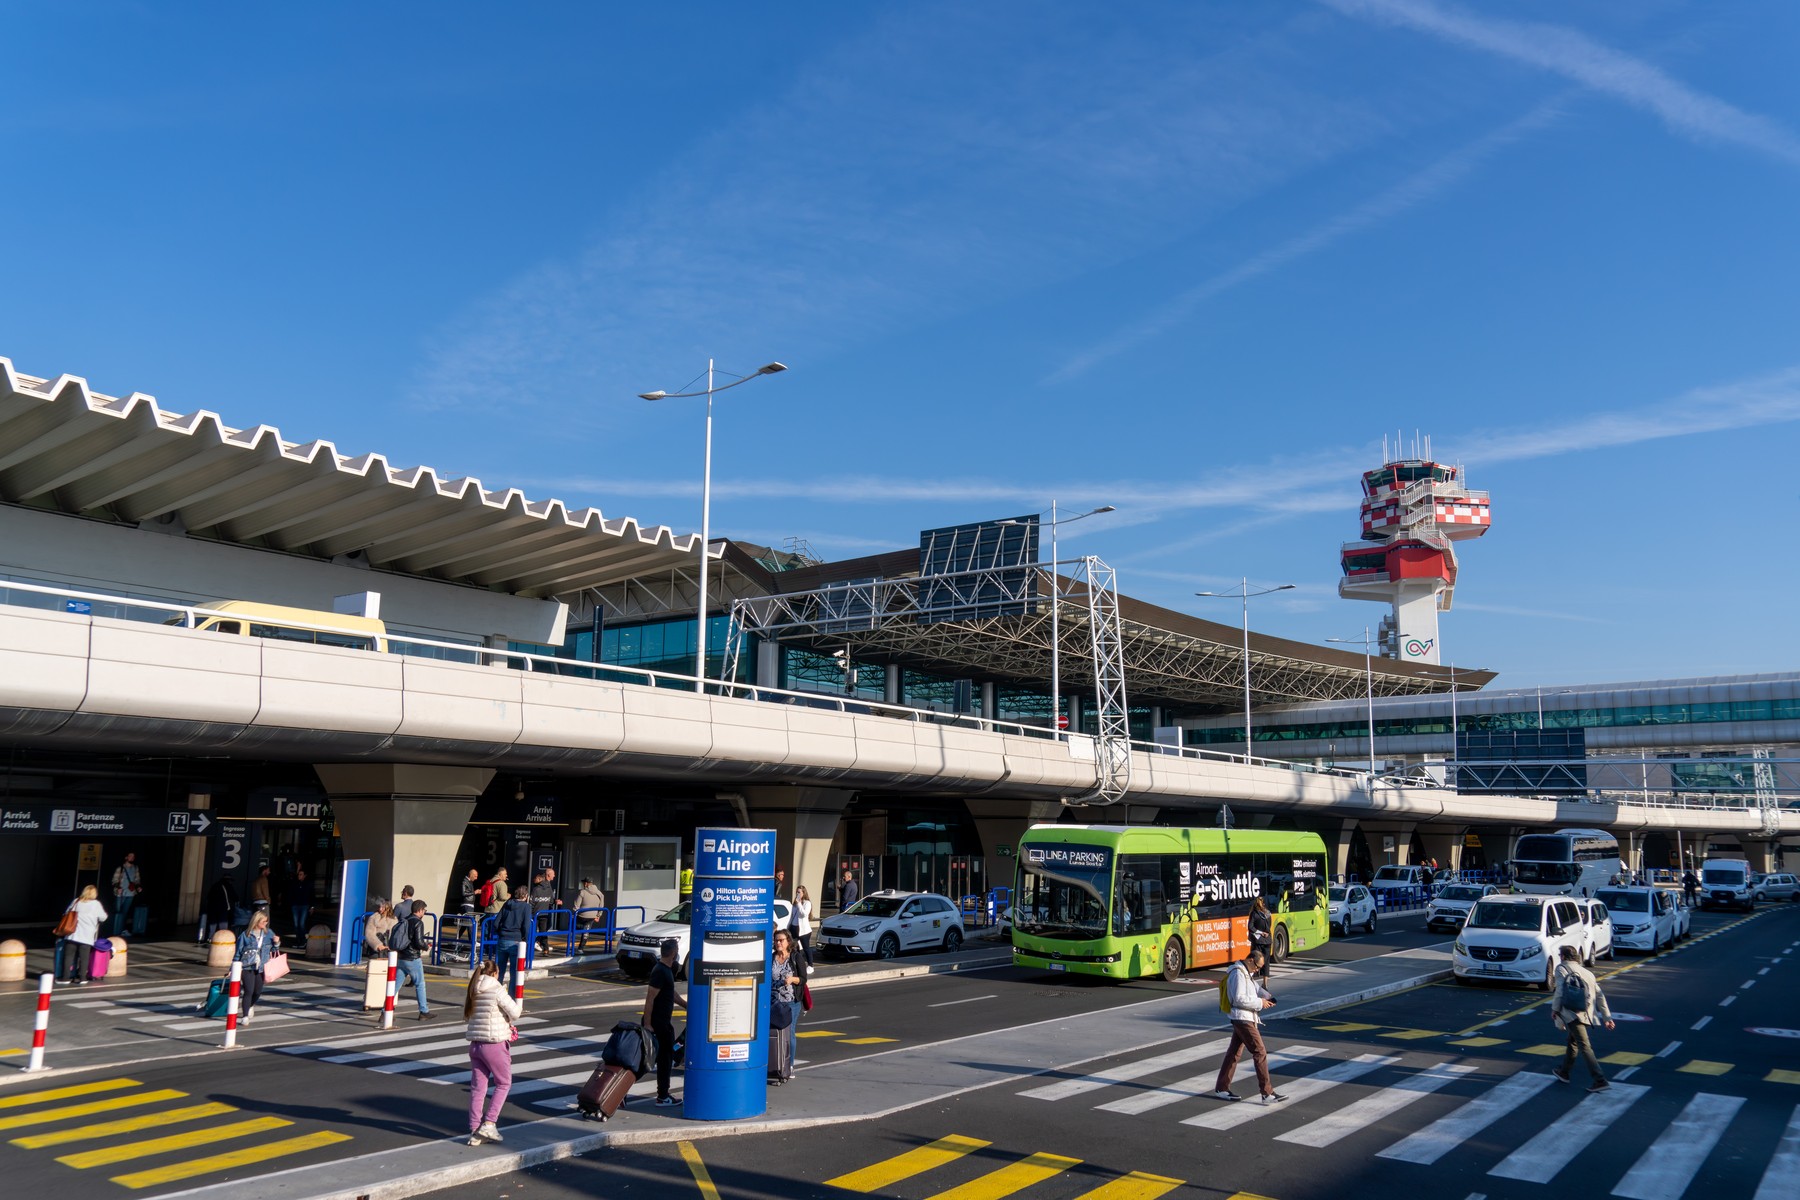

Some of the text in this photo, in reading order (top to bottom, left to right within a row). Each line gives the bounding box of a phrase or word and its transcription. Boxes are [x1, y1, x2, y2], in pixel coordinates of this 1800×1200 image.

[533, 806, 553, 814] Arrivi
[4, 811, 31, 820] Arrivi
[77, 812, 115, 821] Partenze
[172, 814, 187, 825] T1
[526, 814, 552, 822] Arrivals
[2, 820, 39, 829] Arrivals
[76, 821, 124, 831] Departures
[717, 839, 770, 857] Airport
[221, 839, 242, 870] 3
[1045, 850, 1104, 863] LINEA PARKING
[541, 858, 552, 867] T1
[717, 856, 751, 871] Line
[1195, 862, 1218, 876] Airport
[1196, 924, 1204, 933] UN
[1204, 923, 1213, 932] BEL
[1196, 932, 1220, 943] COMINCIA
[1196, 944, 1206, 953] DAL
